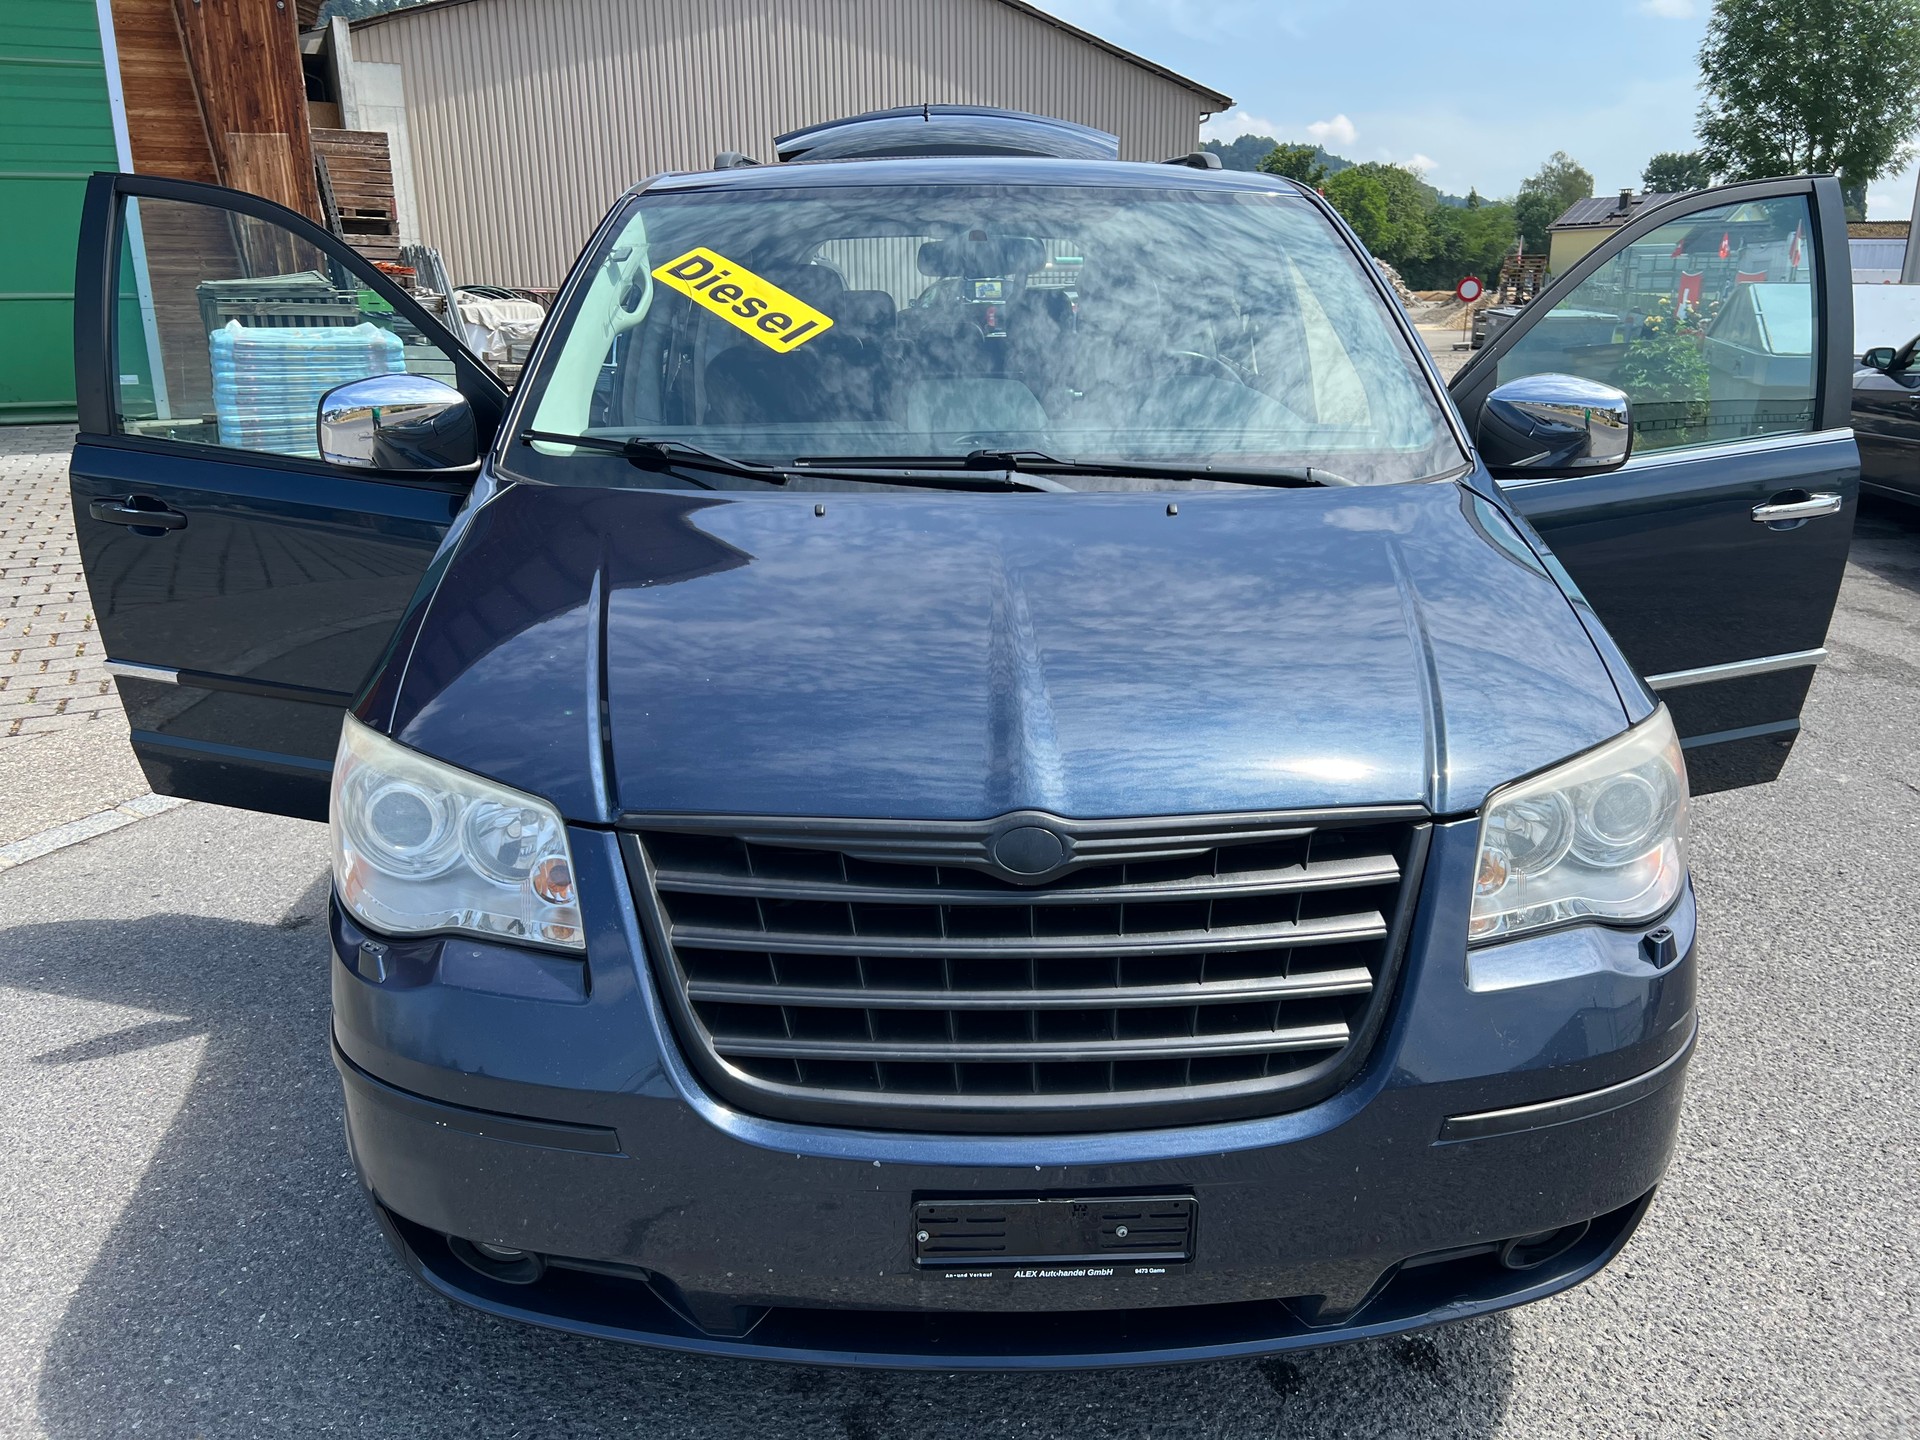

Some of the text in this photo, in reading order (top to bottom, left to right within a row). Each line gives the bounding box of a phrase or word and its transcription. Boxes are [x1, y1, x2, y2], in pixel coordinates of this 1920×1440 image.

[666, 255, 819, 344] Diesel
[1014, 1270, 1038, 1278] ALEX
[1087, 1268, 1114, 1276] GmbH
